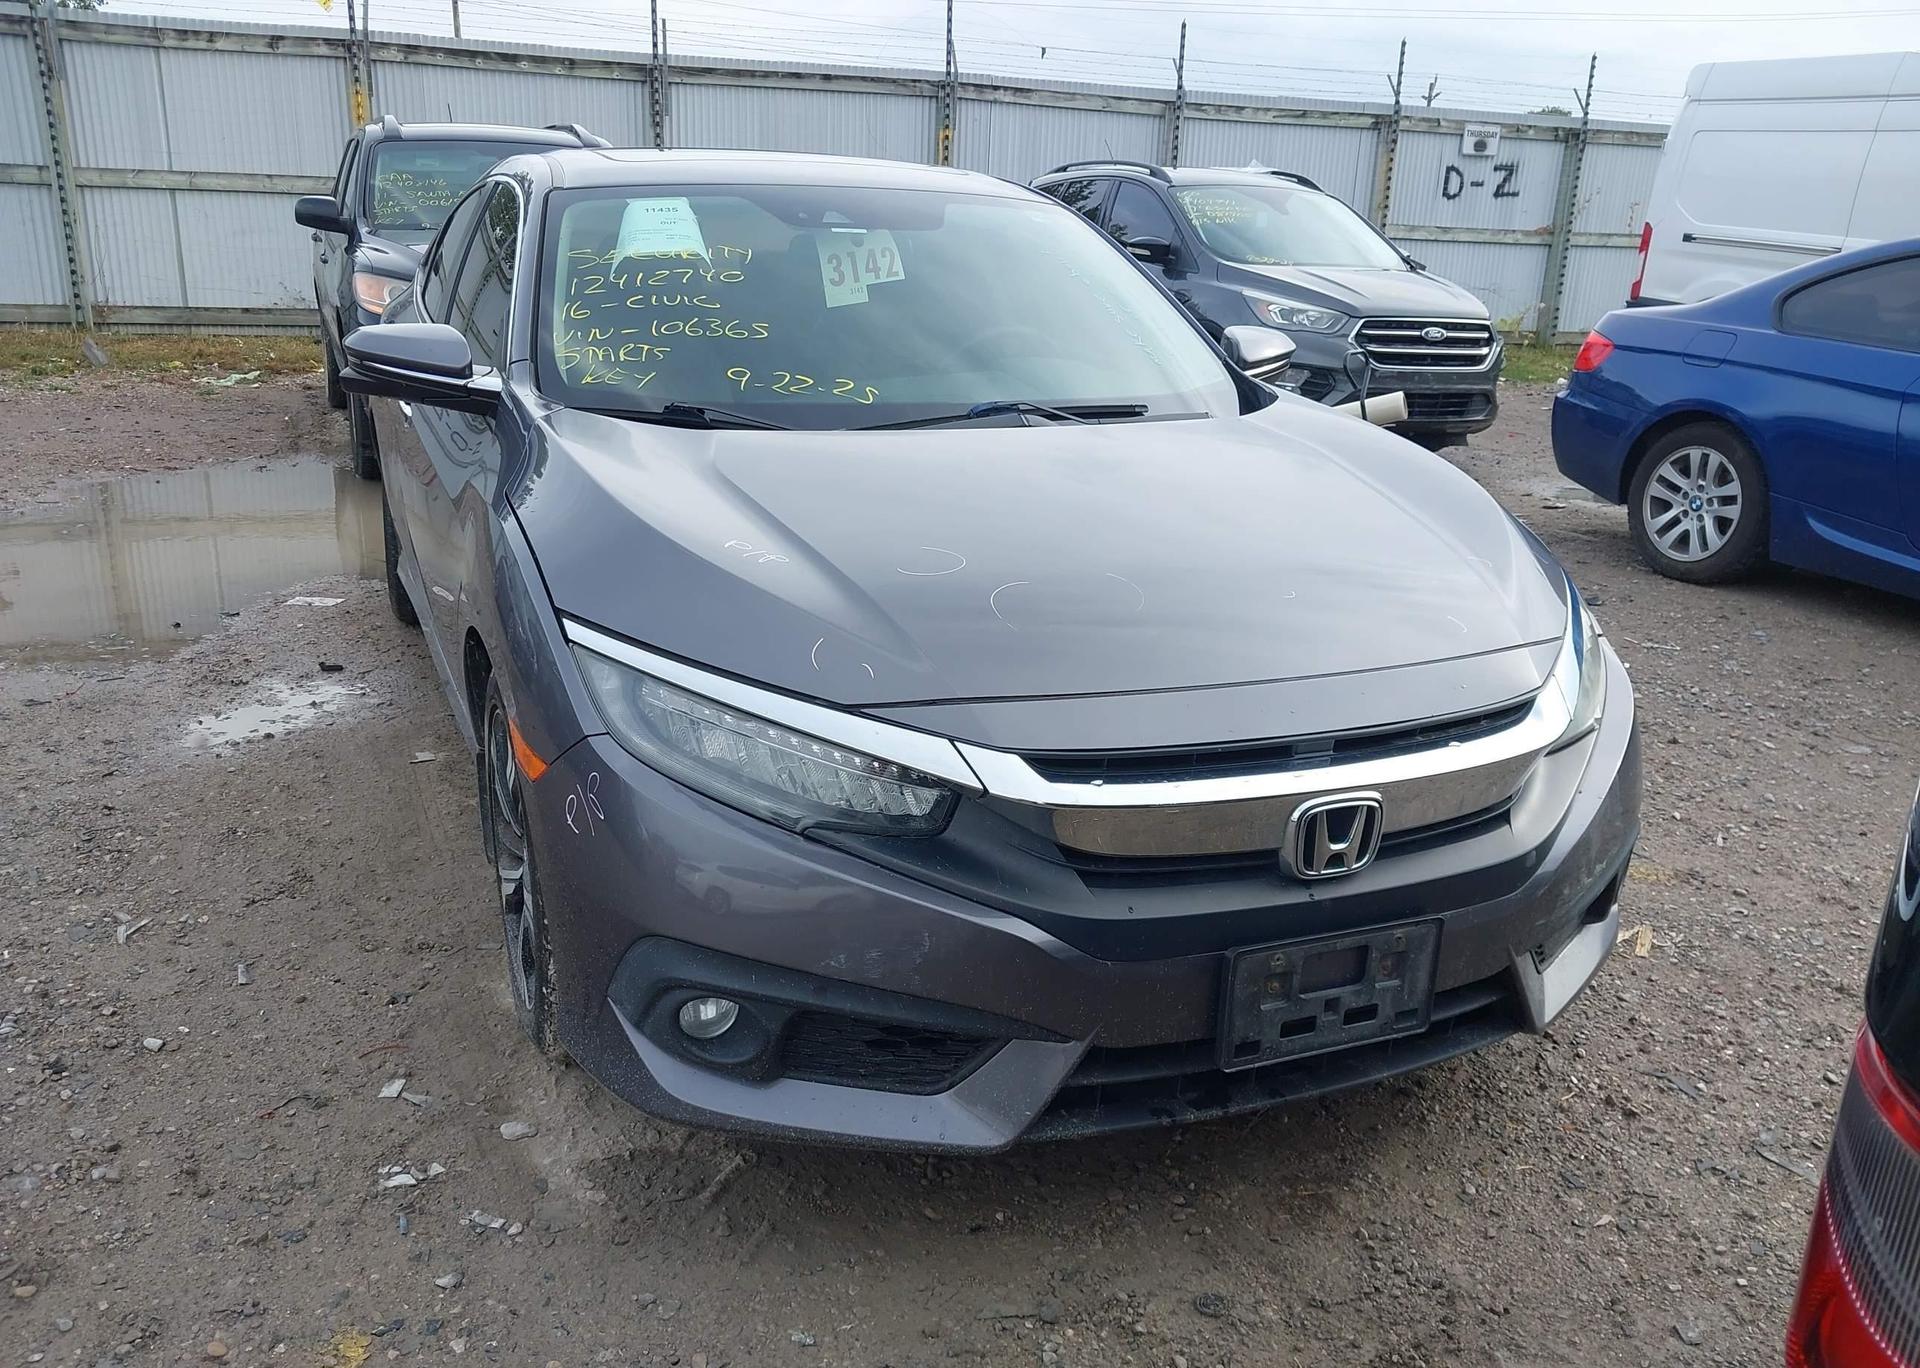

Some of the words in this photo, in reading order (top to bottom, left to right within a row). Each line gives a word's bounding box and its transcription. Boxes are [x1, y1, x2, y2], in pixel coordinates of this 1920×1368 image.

[1466, 129, 1498, 139] THURSDAY
[644, 206, 680, 214] 11435
[827, 246, 900, 288] 3142
[555, 343, 671, 370] STARTS
[580, 364, 656, 389] KEY
